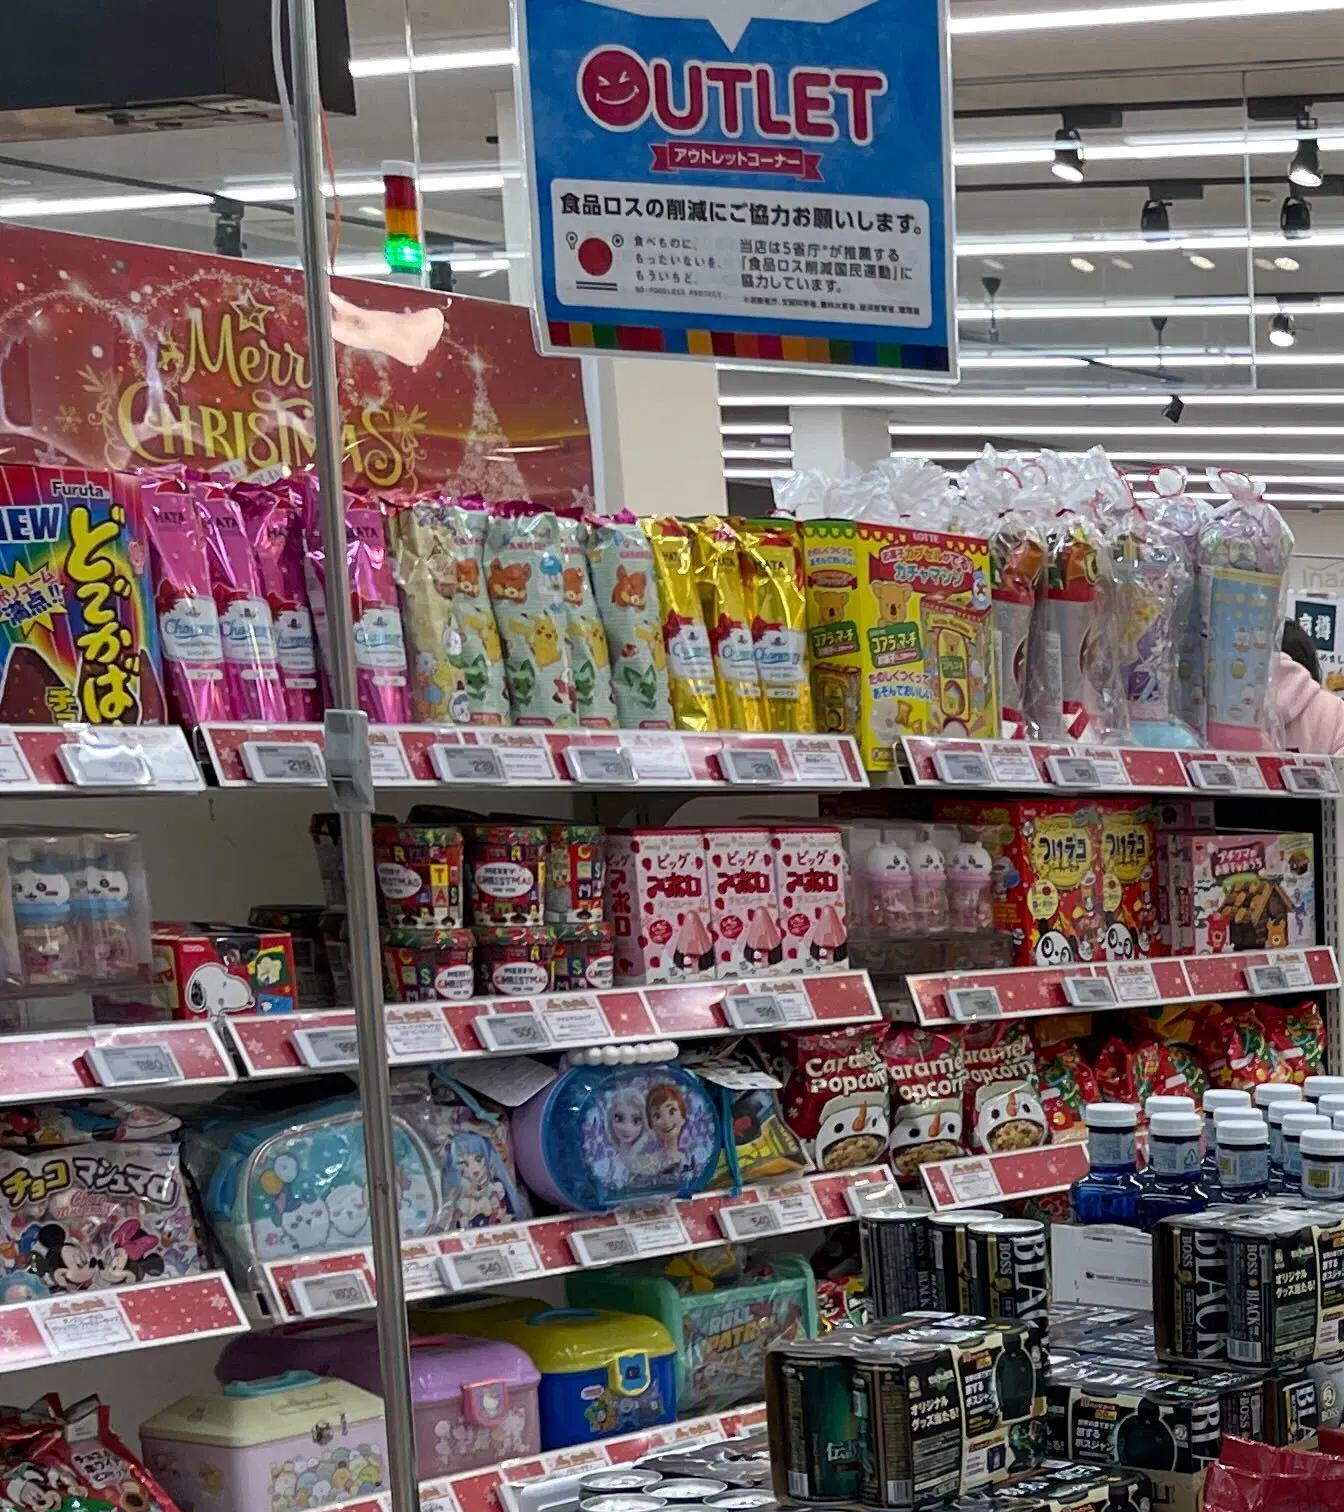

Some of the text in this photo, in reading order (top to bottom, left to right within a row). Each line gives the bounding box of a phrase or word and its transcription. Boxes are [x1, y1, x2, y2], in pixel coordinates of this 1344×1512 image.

[578, 44, 888, 145] OUTLET
[673, 147, 802, 168] アウトレットコーナー
[560, 192, 924, 237] 食品ロスの削減にご協力お願いします。
[741, 275, 843, 294] 協力しています。
[183, 306, 313, 388] Merr
[51, 481, 105, 498] Furuta
[912, 531, 940, 544] LOTTE
[894, 562, 965, 587] ガチャマシン
[657, 853, 691, 871] ビッグ
[727, 850, 759, 867] ビッグ
[796, 849, 829, 866] ビッグ
[476, 874, 533, 886] CHRISTMAS
[483, 866, 517, 876] MERRY
[716, 868, 771, 894] アポロ
[785, 867, 839, 894] アポロ
[646, 872, 702, 899] アポロ
[503, 966, 535, 976] MERRY
[805, 1047, 882, 1078] Caramel
[810, 1067, 888, 1096] Popcorn
[2, 1156, 179, 1208] チョコ マシュマロ
[1181, 1231, 1194, 1267] BOSS
[1246, 1243, 1260, 1331] BOSS BLACK
[1275, 1268, 1308, 1285] オリジナル
[1275, 1280, 1316, 1299] グッズ当たる!
[909, 1395, 950, 1416] オリジナル
[1240, 1390, 1250, 1429] BOSS
[1321, 1409, 1340, 1421] BOSS
[911, 1407, 961, 1432] グッズ当たる!
